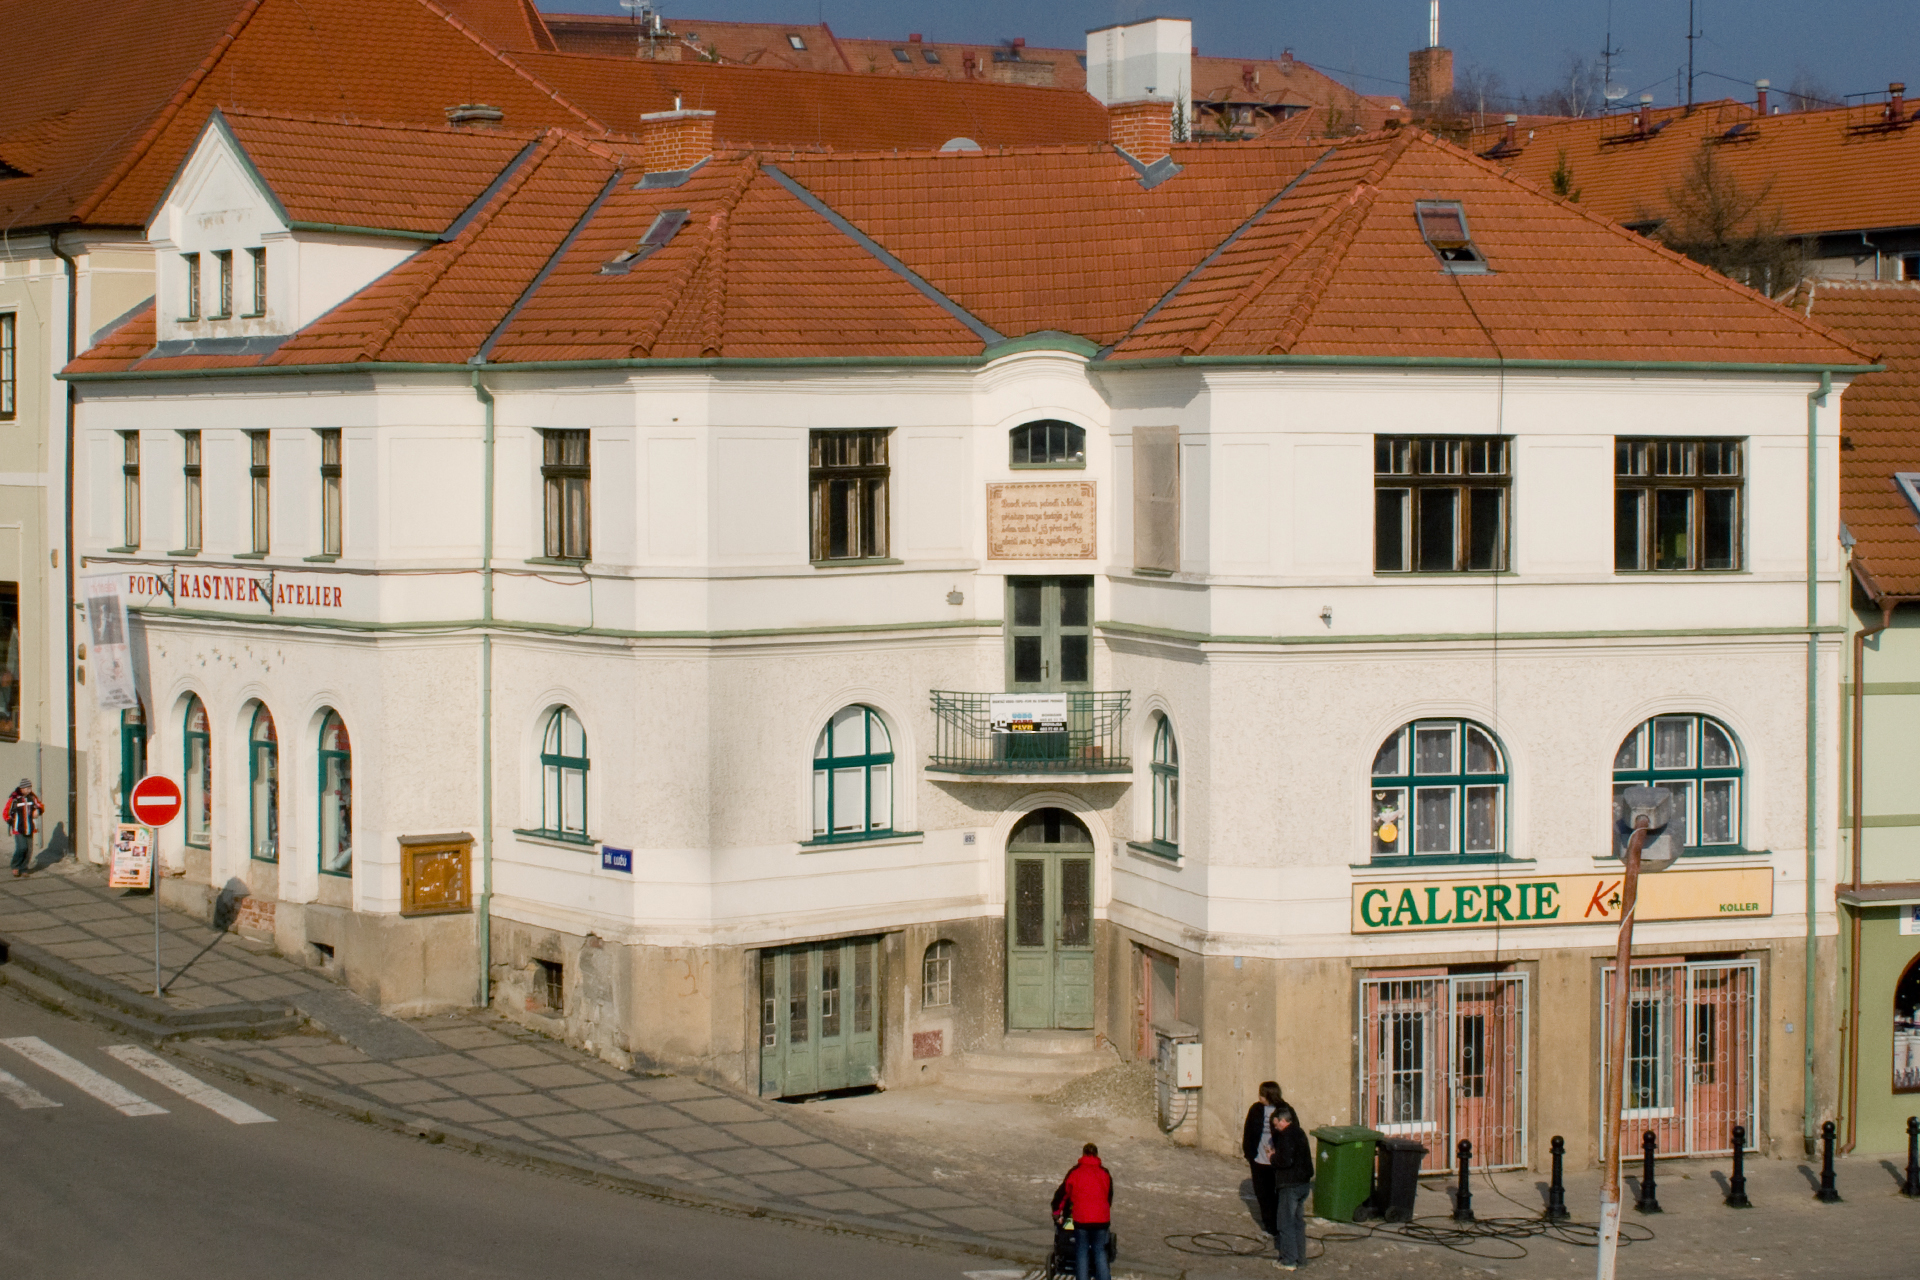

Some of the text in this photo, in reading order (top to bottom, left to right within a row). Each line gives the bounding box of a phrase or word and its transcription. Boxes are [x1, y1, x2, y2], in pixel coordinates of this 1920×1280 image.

[129, 575, 164, 595] FOTO
[180, 574, 259, 602] KASTNER
[276, 584, 342, 607] ATELIER
[1360, 882, 1561, 928] GALERIE
[1719, 902, 1759, 912] KOLLER
